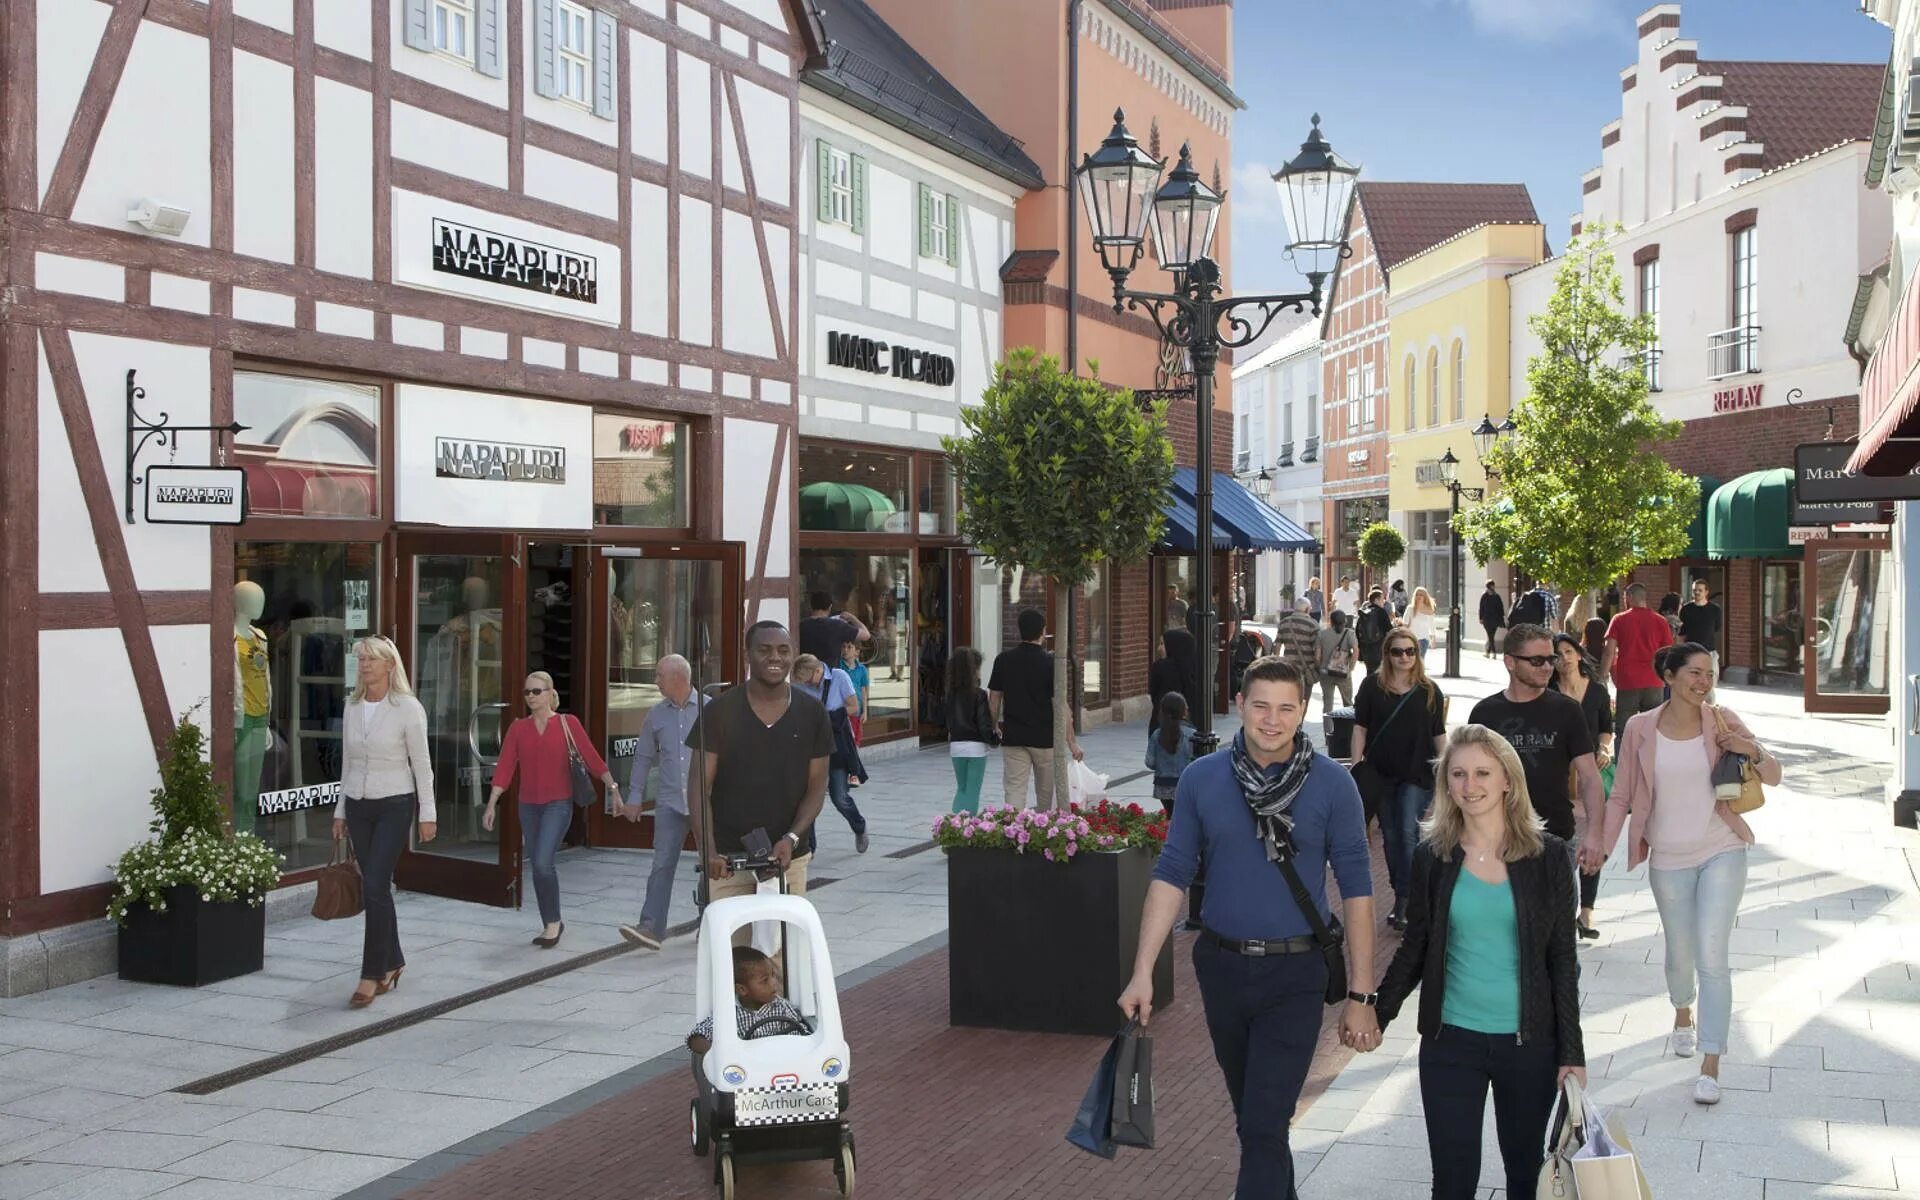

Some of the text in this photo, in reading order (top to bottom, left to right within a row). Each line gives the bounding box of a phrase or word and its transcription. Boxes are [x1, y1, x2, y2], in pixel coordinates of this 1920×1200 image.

[440, 225, 590, 296] NAPAPIJRI
[827, 330, 955, 387] MARC PICARD
[1712, 384, 1764, 412] REPLAY
[441, 441, 560, 480] NAPAPIJRI
[158, 487, 231, 503] NAPAPIJRI
[741, 1093, 833, 1112] McArthur Cars
